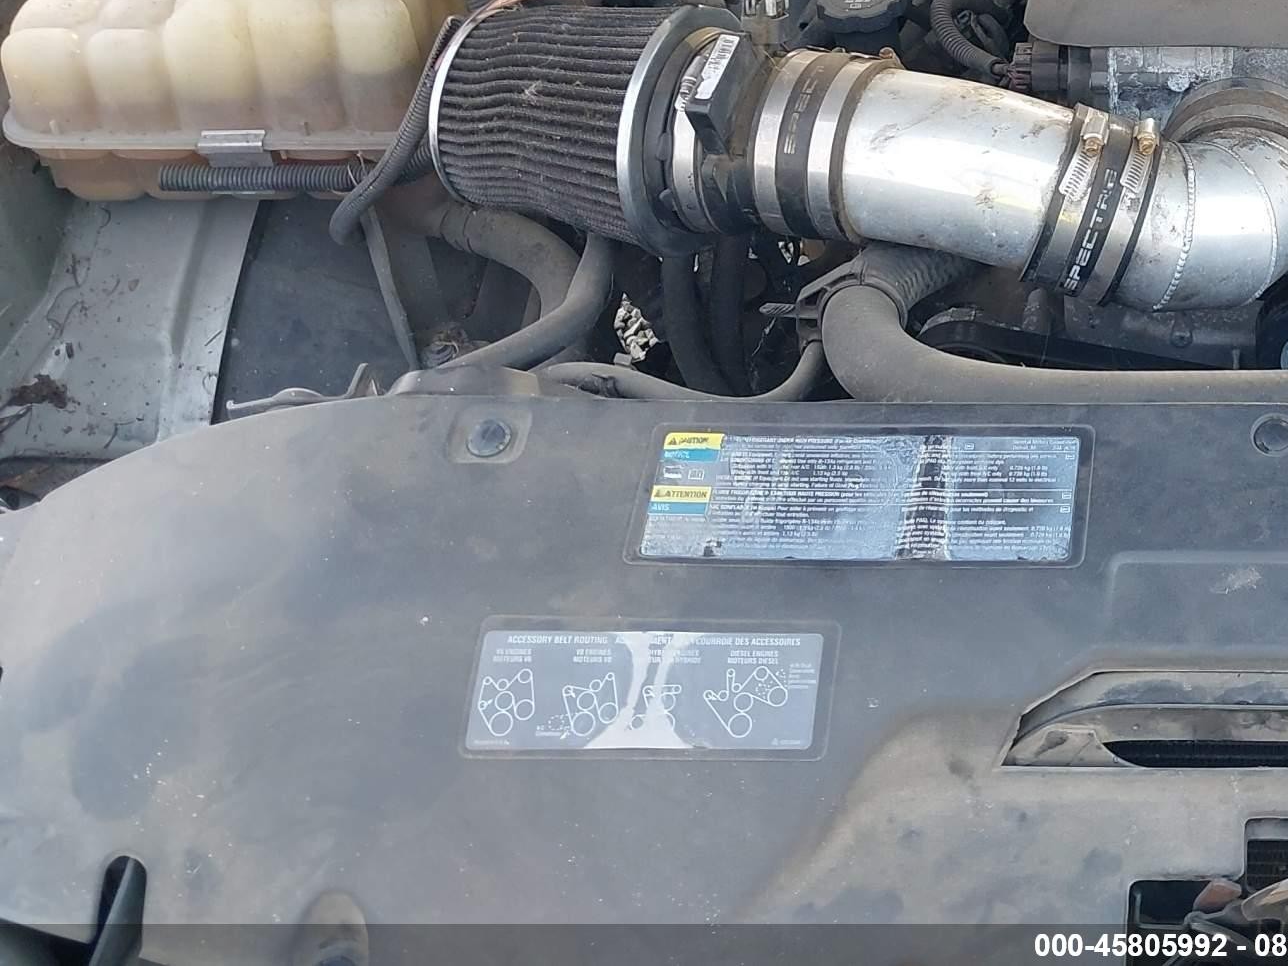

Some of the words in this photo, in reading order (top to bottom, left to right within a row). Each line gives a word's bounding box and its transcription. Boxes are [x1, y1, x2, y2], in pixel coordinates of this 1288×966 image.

[507, 635, 552, 644] ACCESSORY
[553, 636, 572, 644] BELT
[573, 636, 608, 645] ROUTING
[735, 638, 749, 646] DES
[750, 638, 801, 646] ACCESSOIRES
